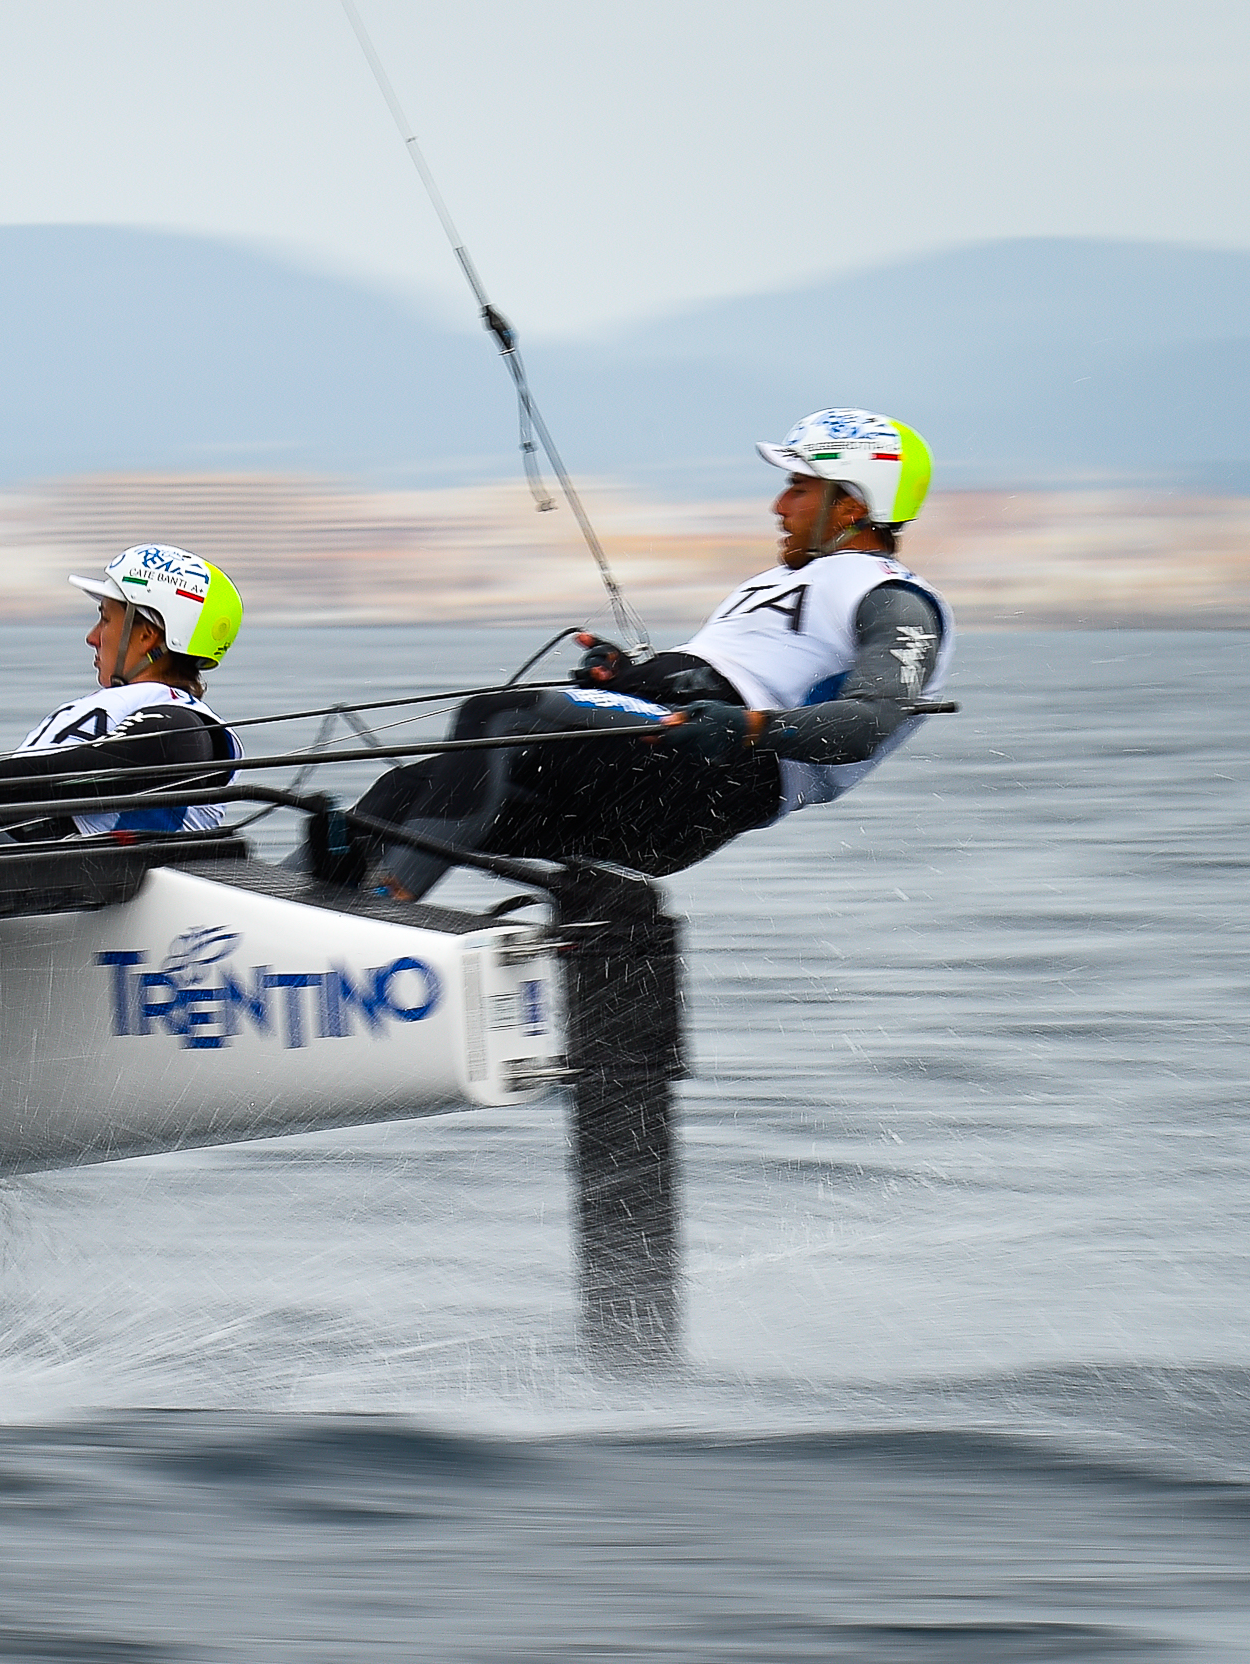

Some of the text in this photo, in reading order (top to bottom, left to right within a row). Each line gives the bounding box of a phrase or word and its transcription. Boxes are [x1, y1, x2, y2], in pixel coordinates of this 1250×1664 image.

[129, 567, 155, 580] CATE
[157, 573, 187, 588] BANTI
[94, 949, 444, 1050] TRENTINO
